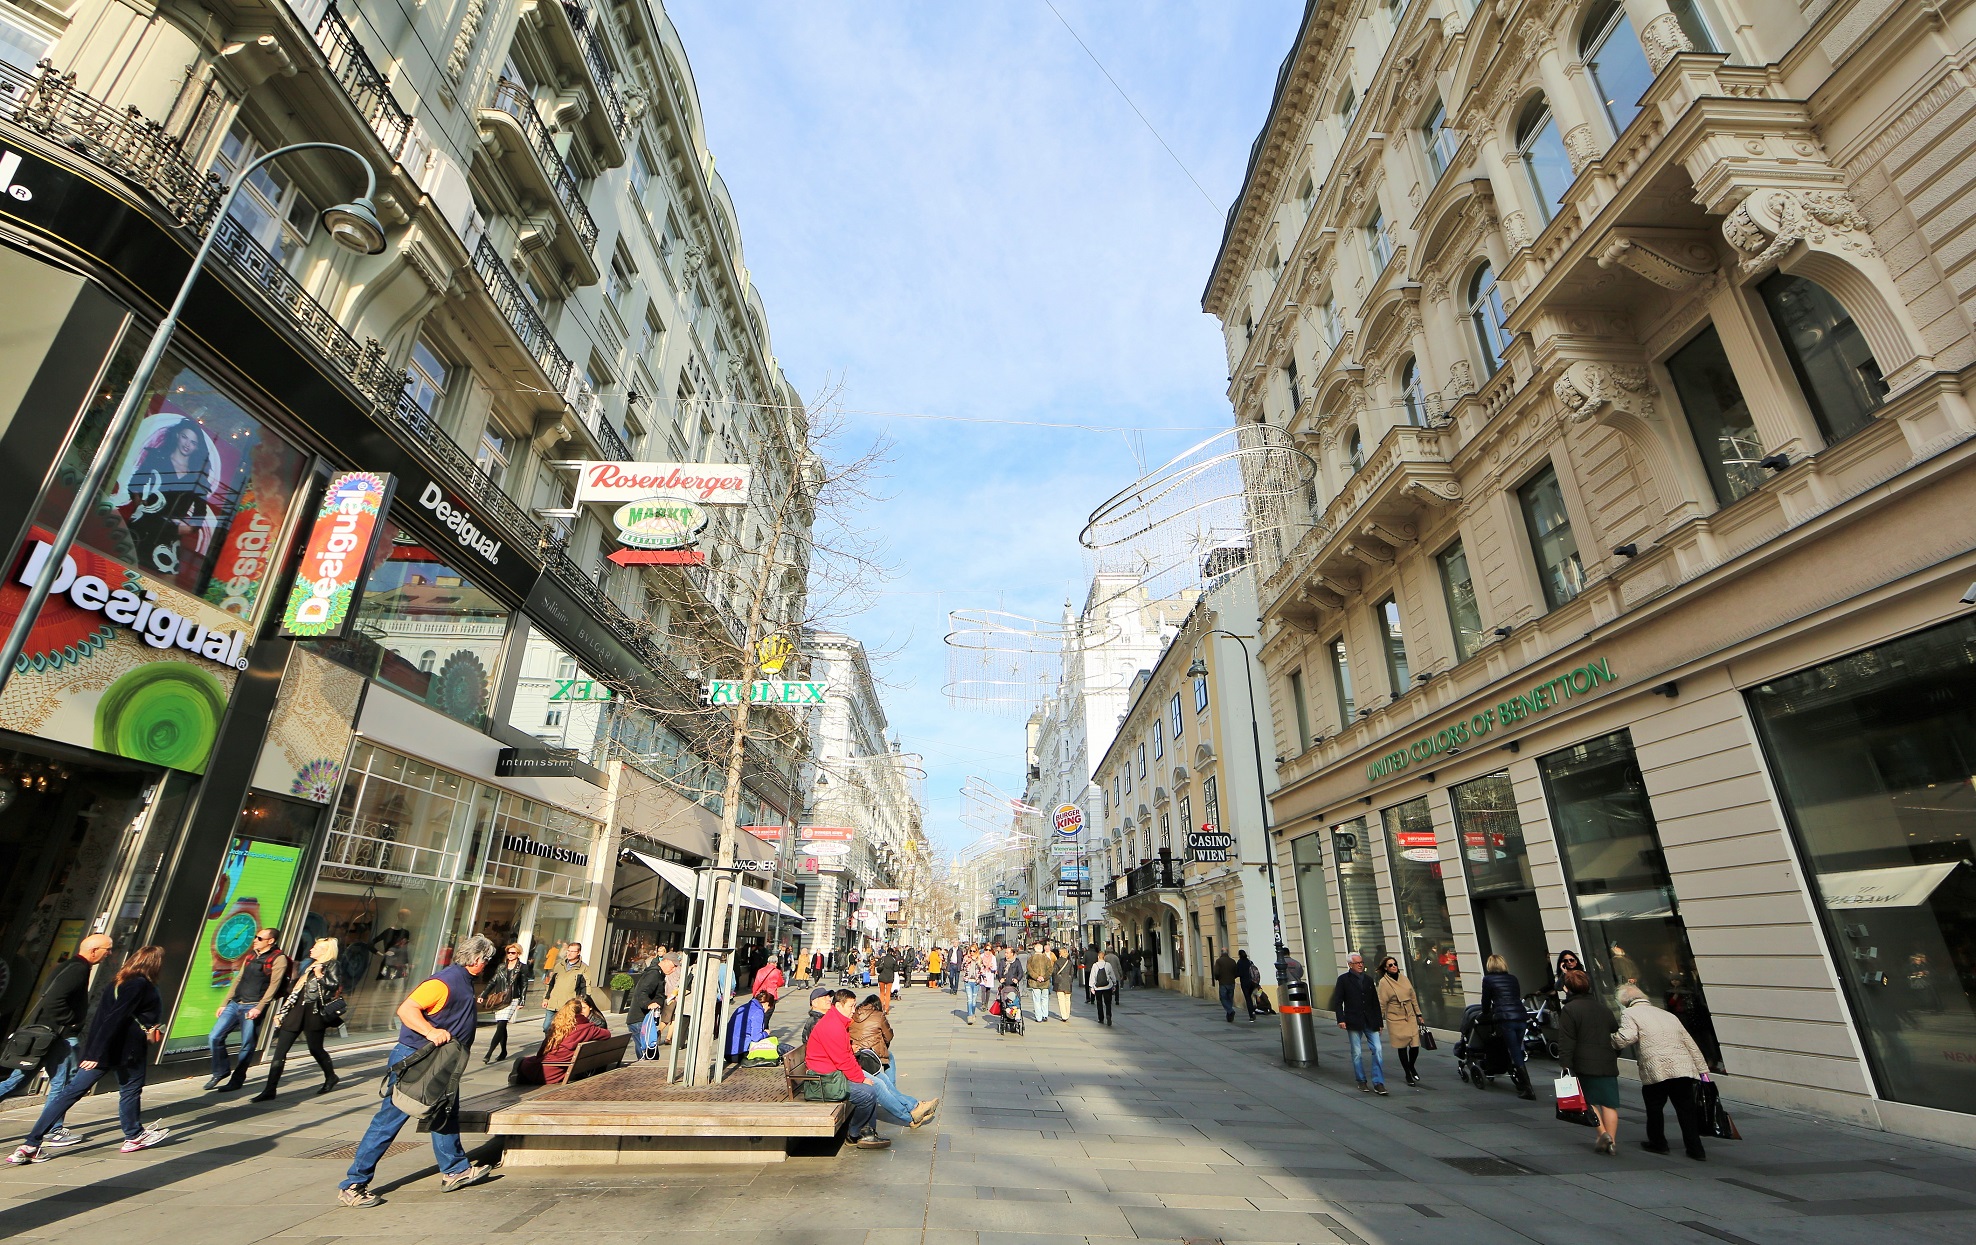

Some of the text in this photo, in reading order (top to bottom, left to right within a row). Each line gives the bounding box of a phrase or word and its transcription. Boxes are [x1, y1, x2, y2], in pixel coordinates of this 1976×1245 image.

[588, 464, 744, 499] Rosenberger
[418, 481, 502, 564] Desigual
[628, 507, 692, 527] MARKT
[295, 489, 367, 623] Desigual
[19, 540, 246, 668] Desigual
[578, 629, 615, 663] BVLGARI
[711, 681, 827, 704] ROLEX
[1366, 749, 1410, 782] UNITED
[1410, 721, 1471, 762] COLORS
[1471, 708, 1495, 737] OF
[501, 757, 574, 767] intimissimi
[1056, 810, 1080, 821] BURGER
[1057, 815, 1082, 830] KING
[1189, 834, 1230, 847] CASINO
[732, 860, 776, 871] WAGNER
[1196, 850, 1225, 861] WIEN
